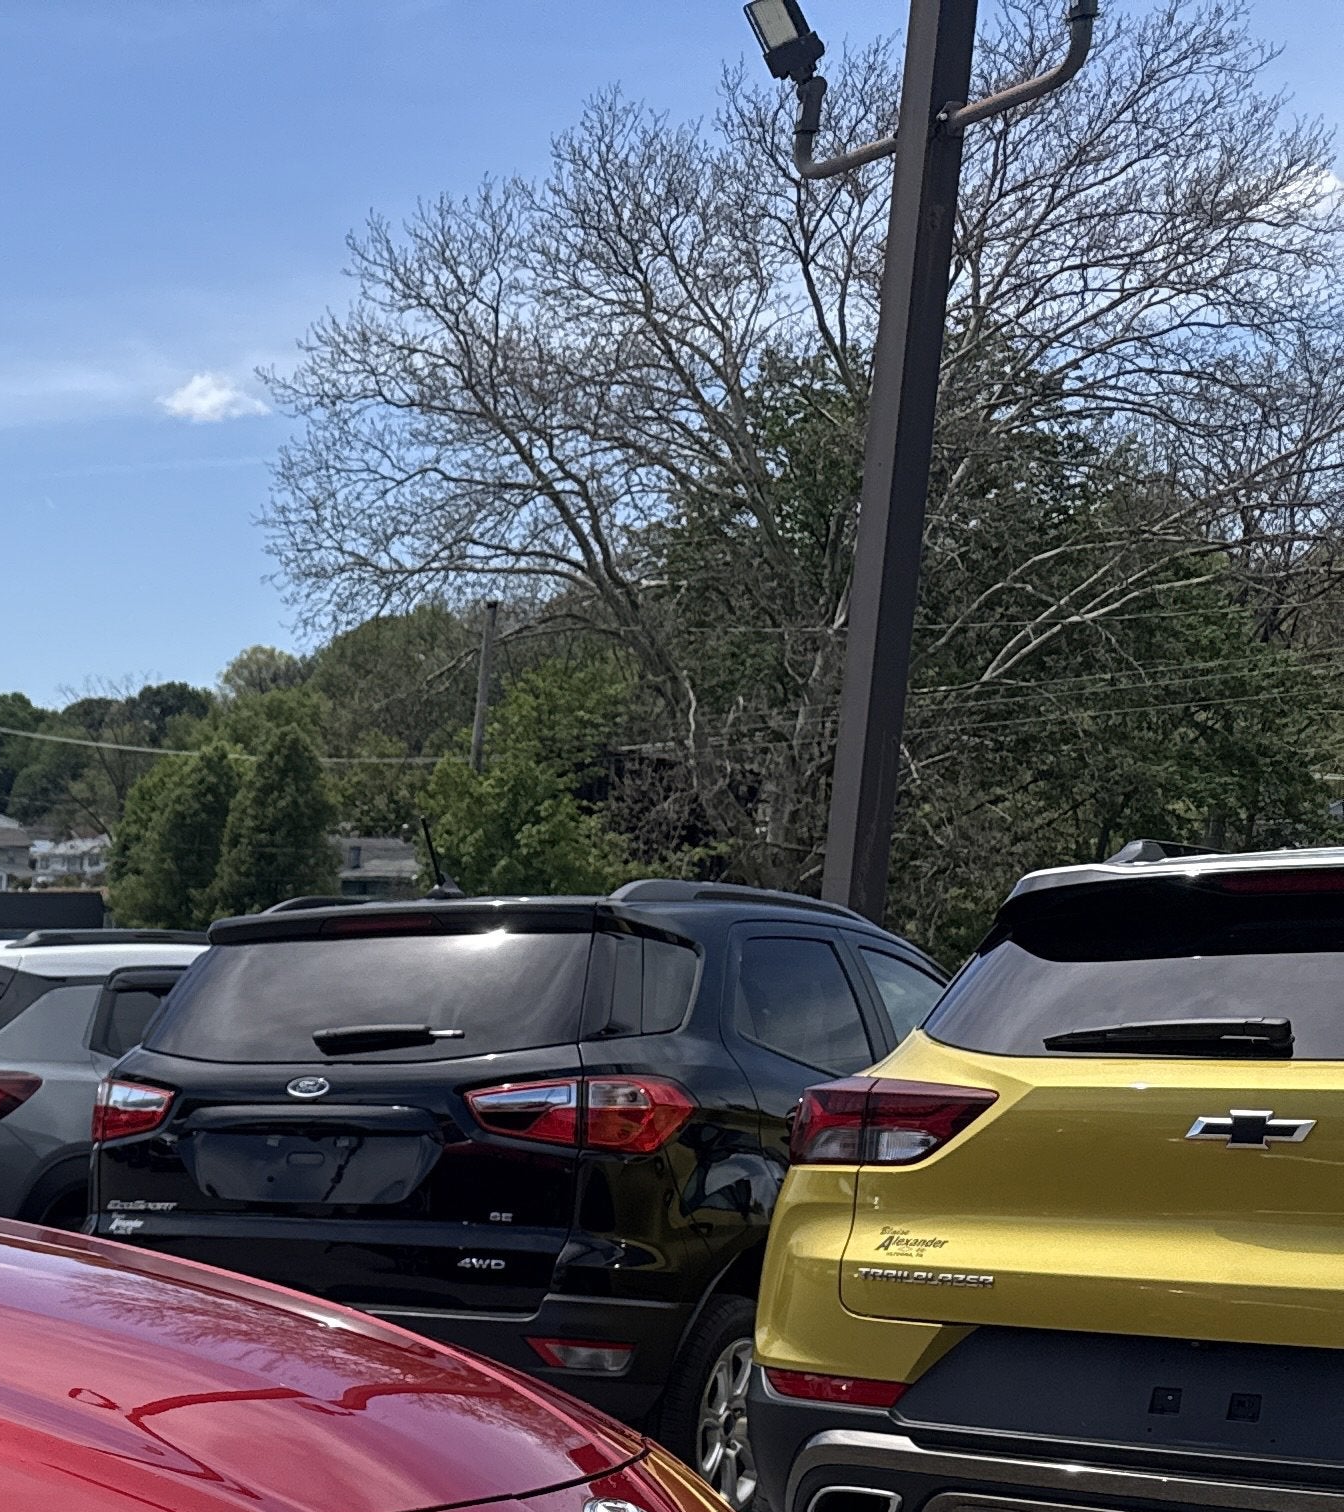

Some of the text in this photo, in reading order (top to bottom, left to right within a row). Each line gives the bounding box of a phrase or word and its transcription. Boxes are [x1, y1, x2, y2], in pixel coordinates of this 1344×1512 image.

[879, 1226, 910, 1236] Blaise
[874, 1235, 949, 1251] Alexander
[457, 1257, 506, 1270] 4WD
[858, 1267, 995, 1288] TRAILBLAZER
